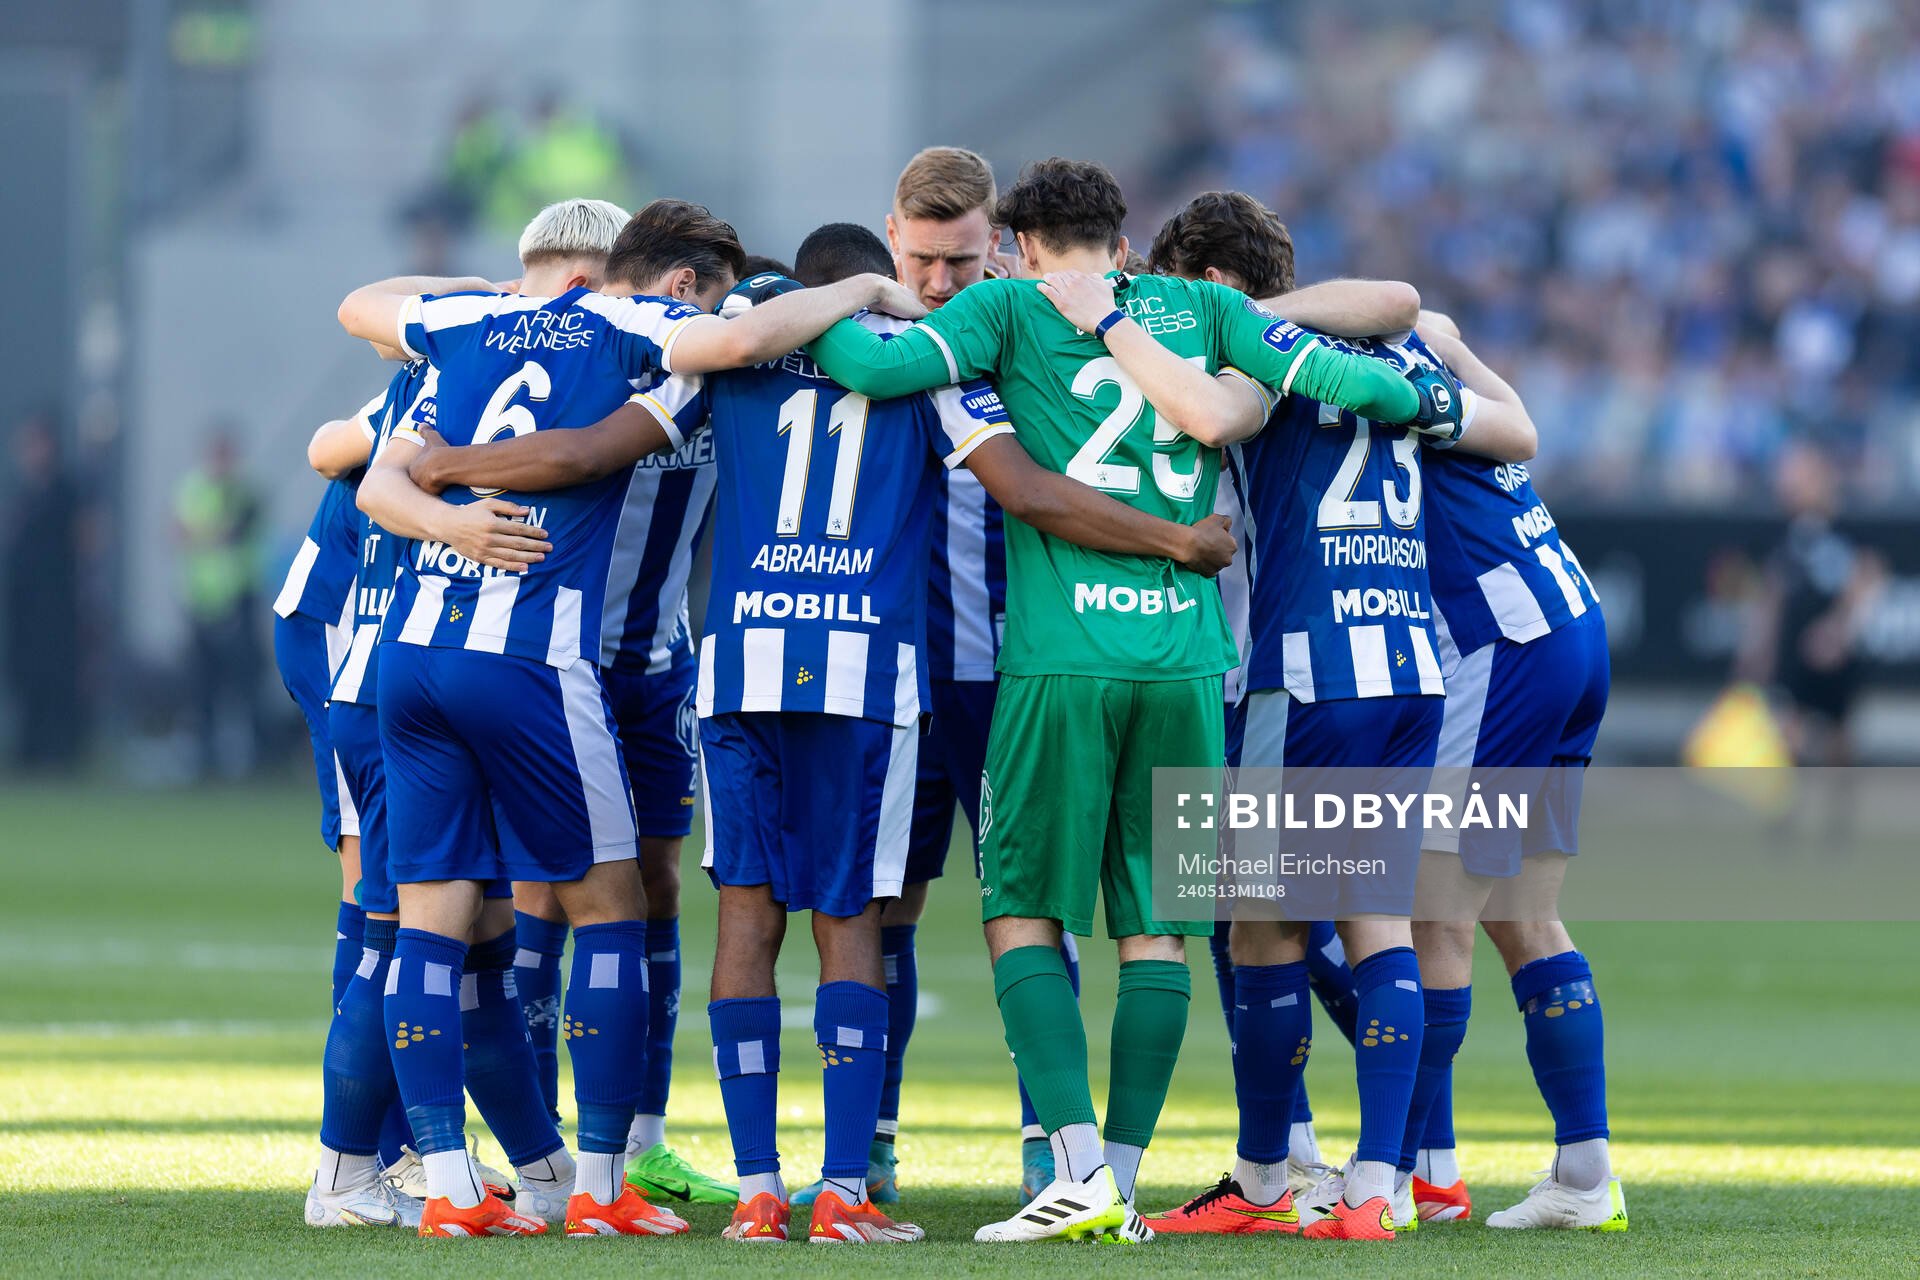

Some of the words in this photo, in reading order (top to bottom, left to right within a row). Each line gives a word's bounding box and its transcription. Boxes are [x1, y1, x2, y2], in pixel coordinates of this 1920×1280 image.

[468, 360, 551, 498] 6
[776, 389, 870, 540] 11
[1317, 402, 1422, 531] 23
[751, 544, 874, 575] ABRAHAM
[1320, 535, 1426, 569] THORDARSON
[733, 590, 881, 624] MOBILL
[1332, 588, 1430, 623] MOBILL
